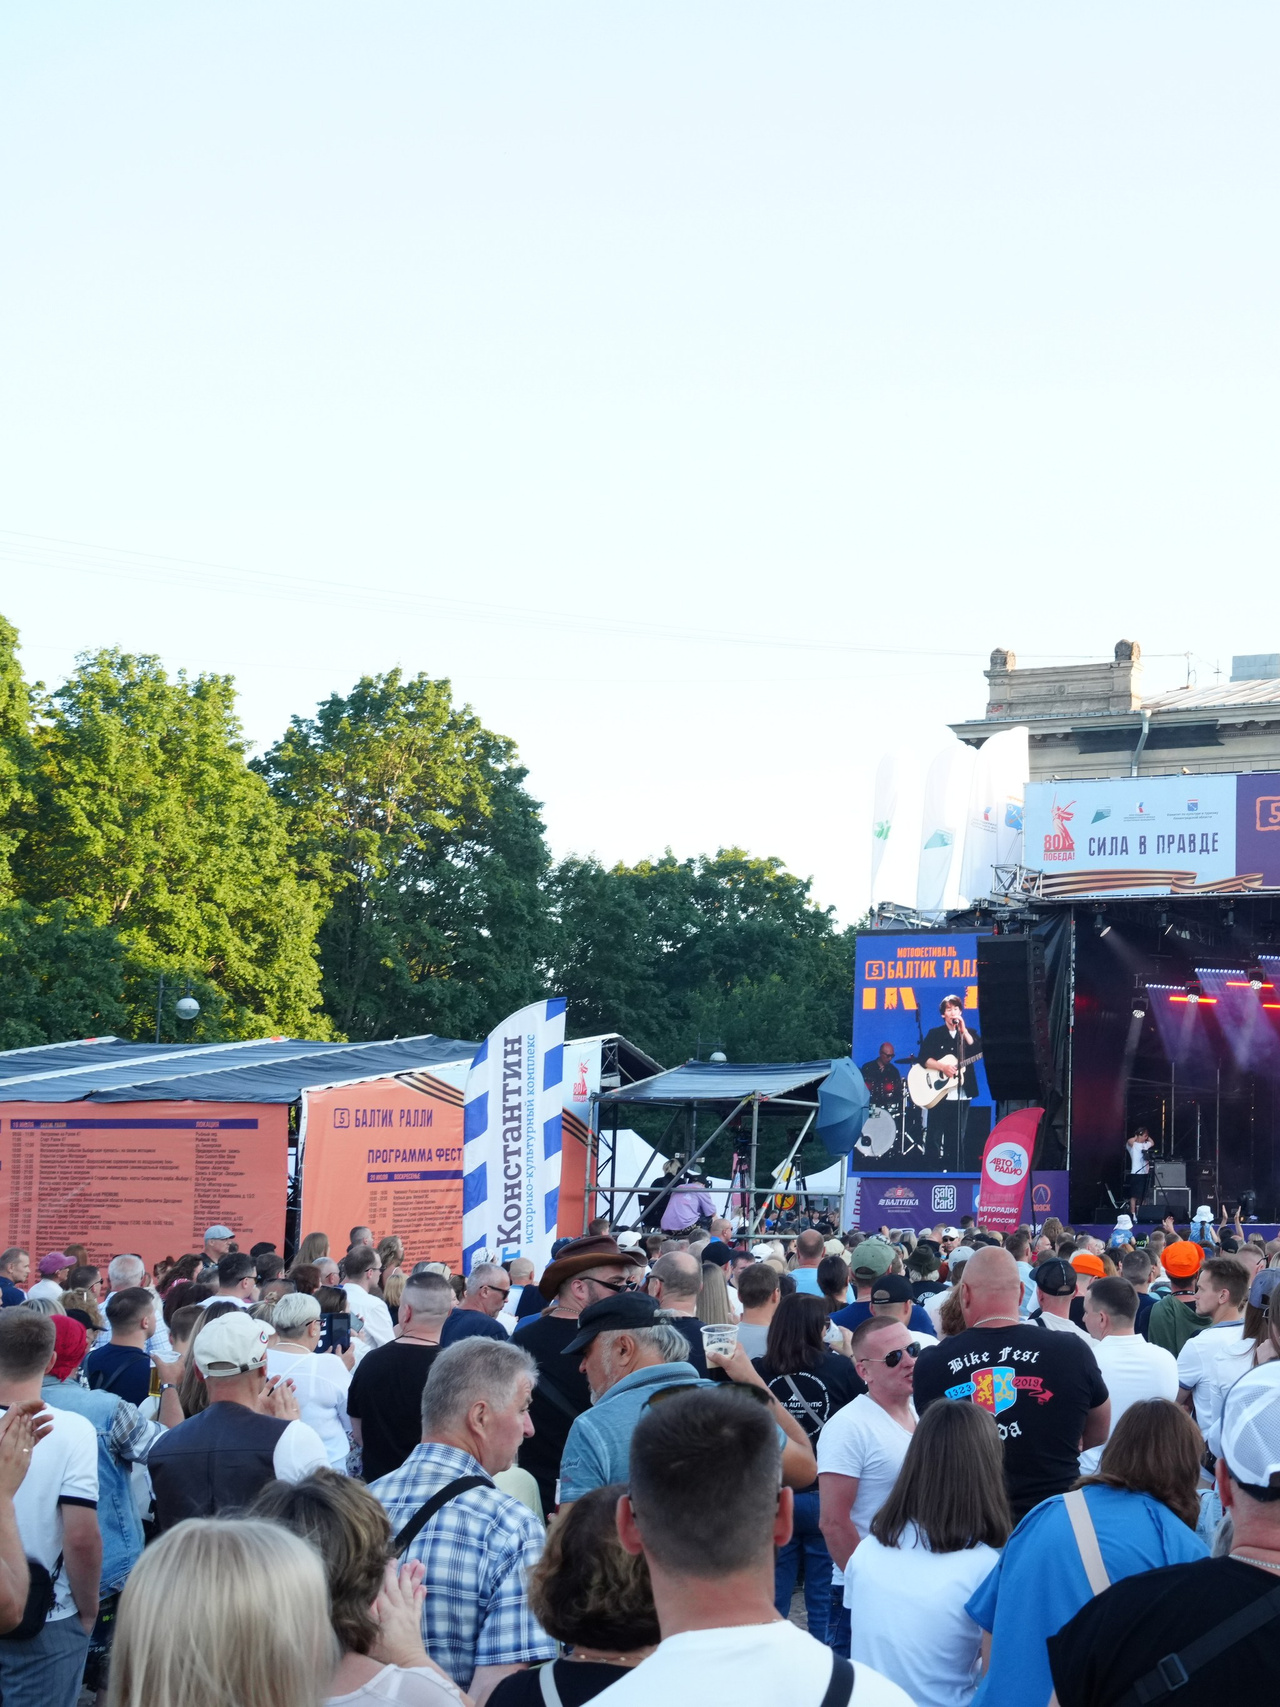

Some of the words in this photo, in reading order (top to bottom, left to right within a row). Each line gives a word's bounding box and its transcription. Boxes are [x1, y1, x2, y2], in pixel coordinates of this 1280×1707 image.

[1044, 834, 1061, 851] 80
[1088, 834, 1129, 857] СИЛА
[1139, 834, 1147, 855] В
[1157, 832, 1219, 855] ПРАВДЕ
[1043, 852, 1075, 862] ПОБЕДА!
[897, 946, 957, 958] МОТОФЕСТИВАЛЬ
[887, 960, 936, 979] БАЛТИК
[526, 1034, 536, 1095] комплекс
[355, 1109, 394, 1128] БАЛТИК
[399, 1109, 433, 1127] РАЛЛИ
[497, 1035, 522, 1248] Константин
[367, 1149, 433, 1164] ПРОГРАММА
[436, 1147, 463, 1162] ФЕСТ
[989, 1158, 1012, 1167] АВТО
[525, 1102, 536, 1244] историко-культурный
[994, 1165, 1022, 1176] РАДИО
[934, 1187, 953, 1199] safe
[883, 1198, 919, 1206] БАЛТИКА
[934, 1199, 953, 1210] care
[947, 1351, 990, 1375] Bike
[997, 1346, 1040, 1364] Fest
[1014, 1378, 1040, 1387] 2019
[947, 1384, 973, 1398] 1323
